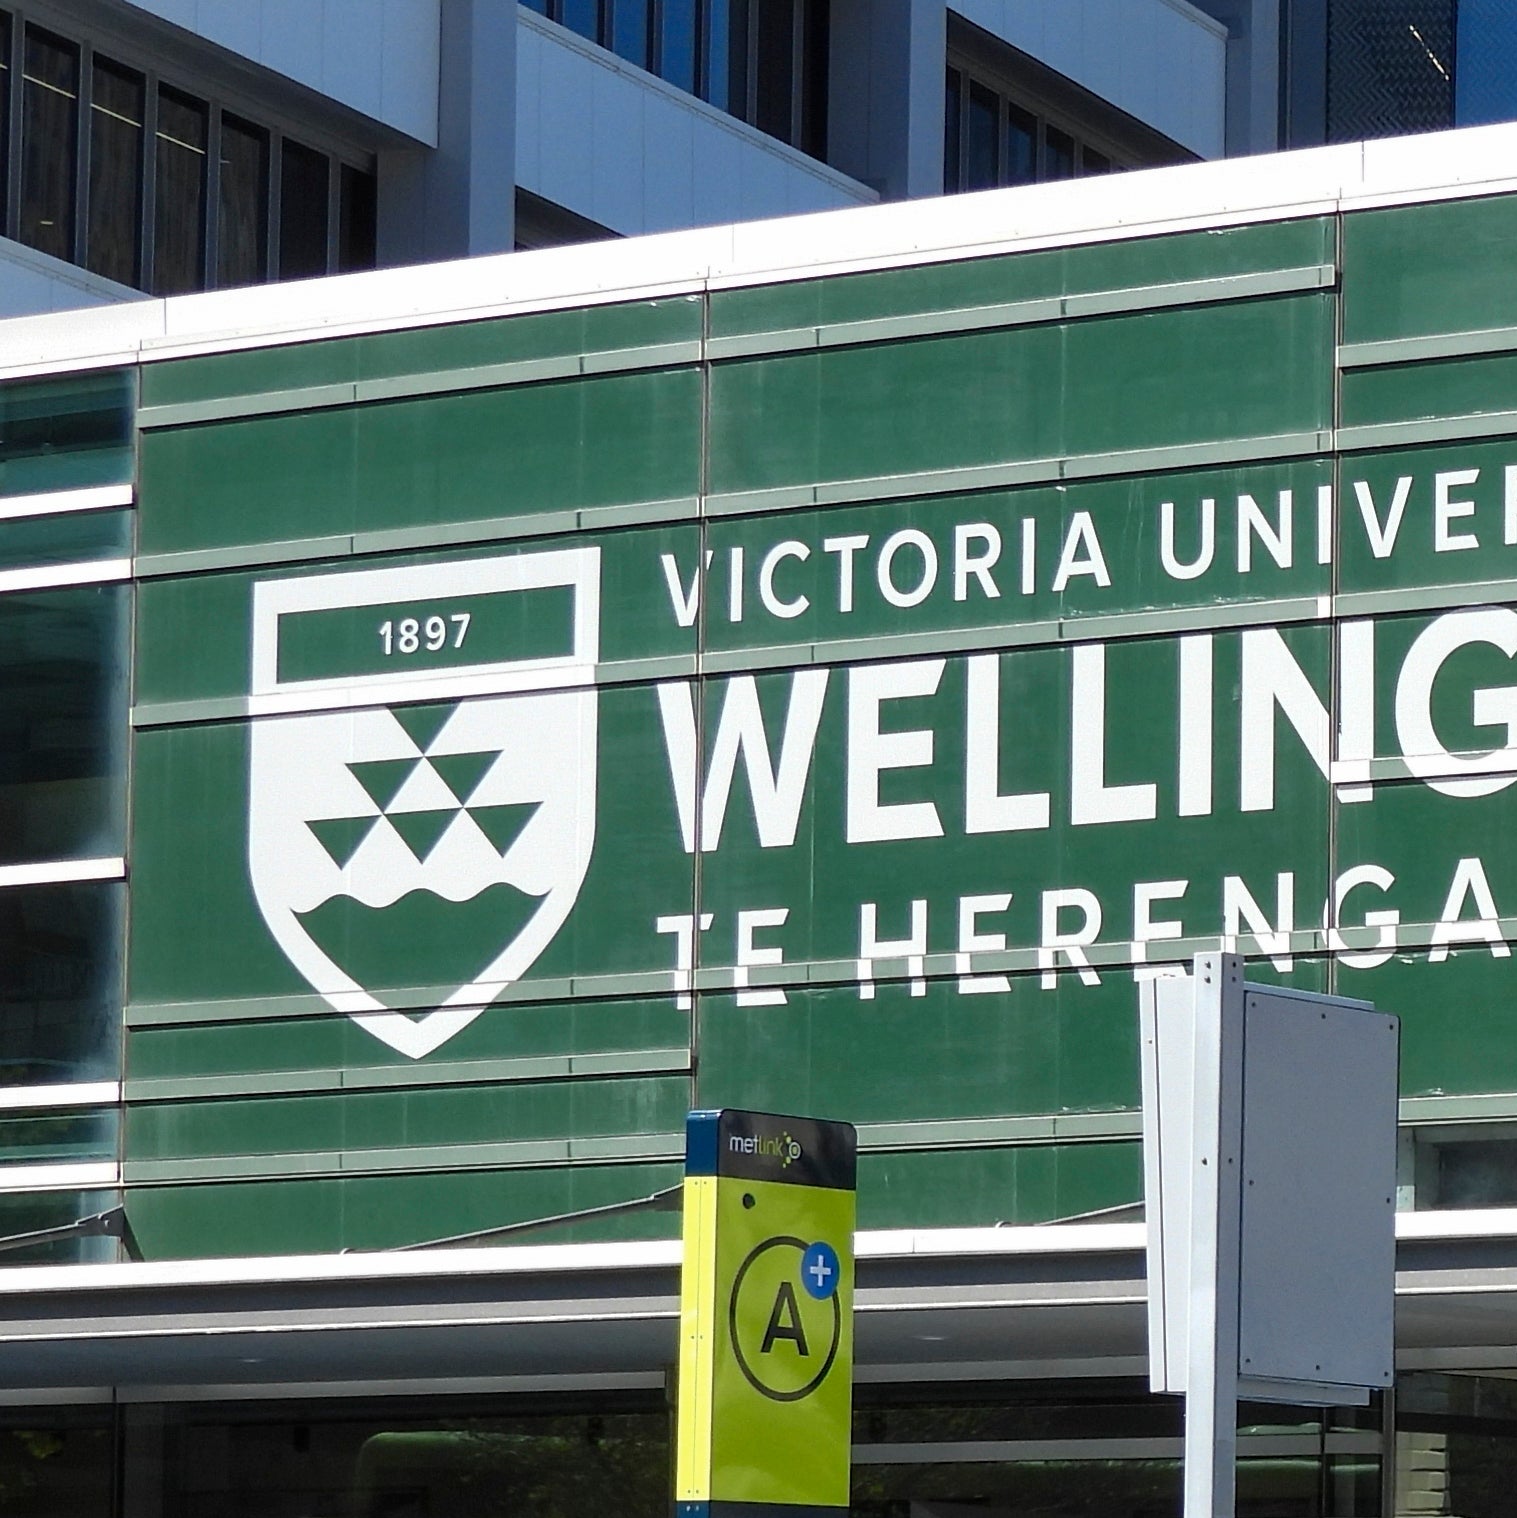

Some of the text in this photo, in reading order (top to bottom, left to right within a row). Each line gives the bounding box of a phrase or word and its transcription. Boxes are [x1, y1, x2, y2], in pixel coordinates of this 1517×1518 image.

[661, 511, 1111, 627] VICTORIA
[380, 613, 471, 655] 1897
[655, 908, 789, 1010] TE
[856, 857, 1511, 999] HERENGA
[729, 1133, 783, 1157] metlink
[760, 1281, 809, 1356] A
